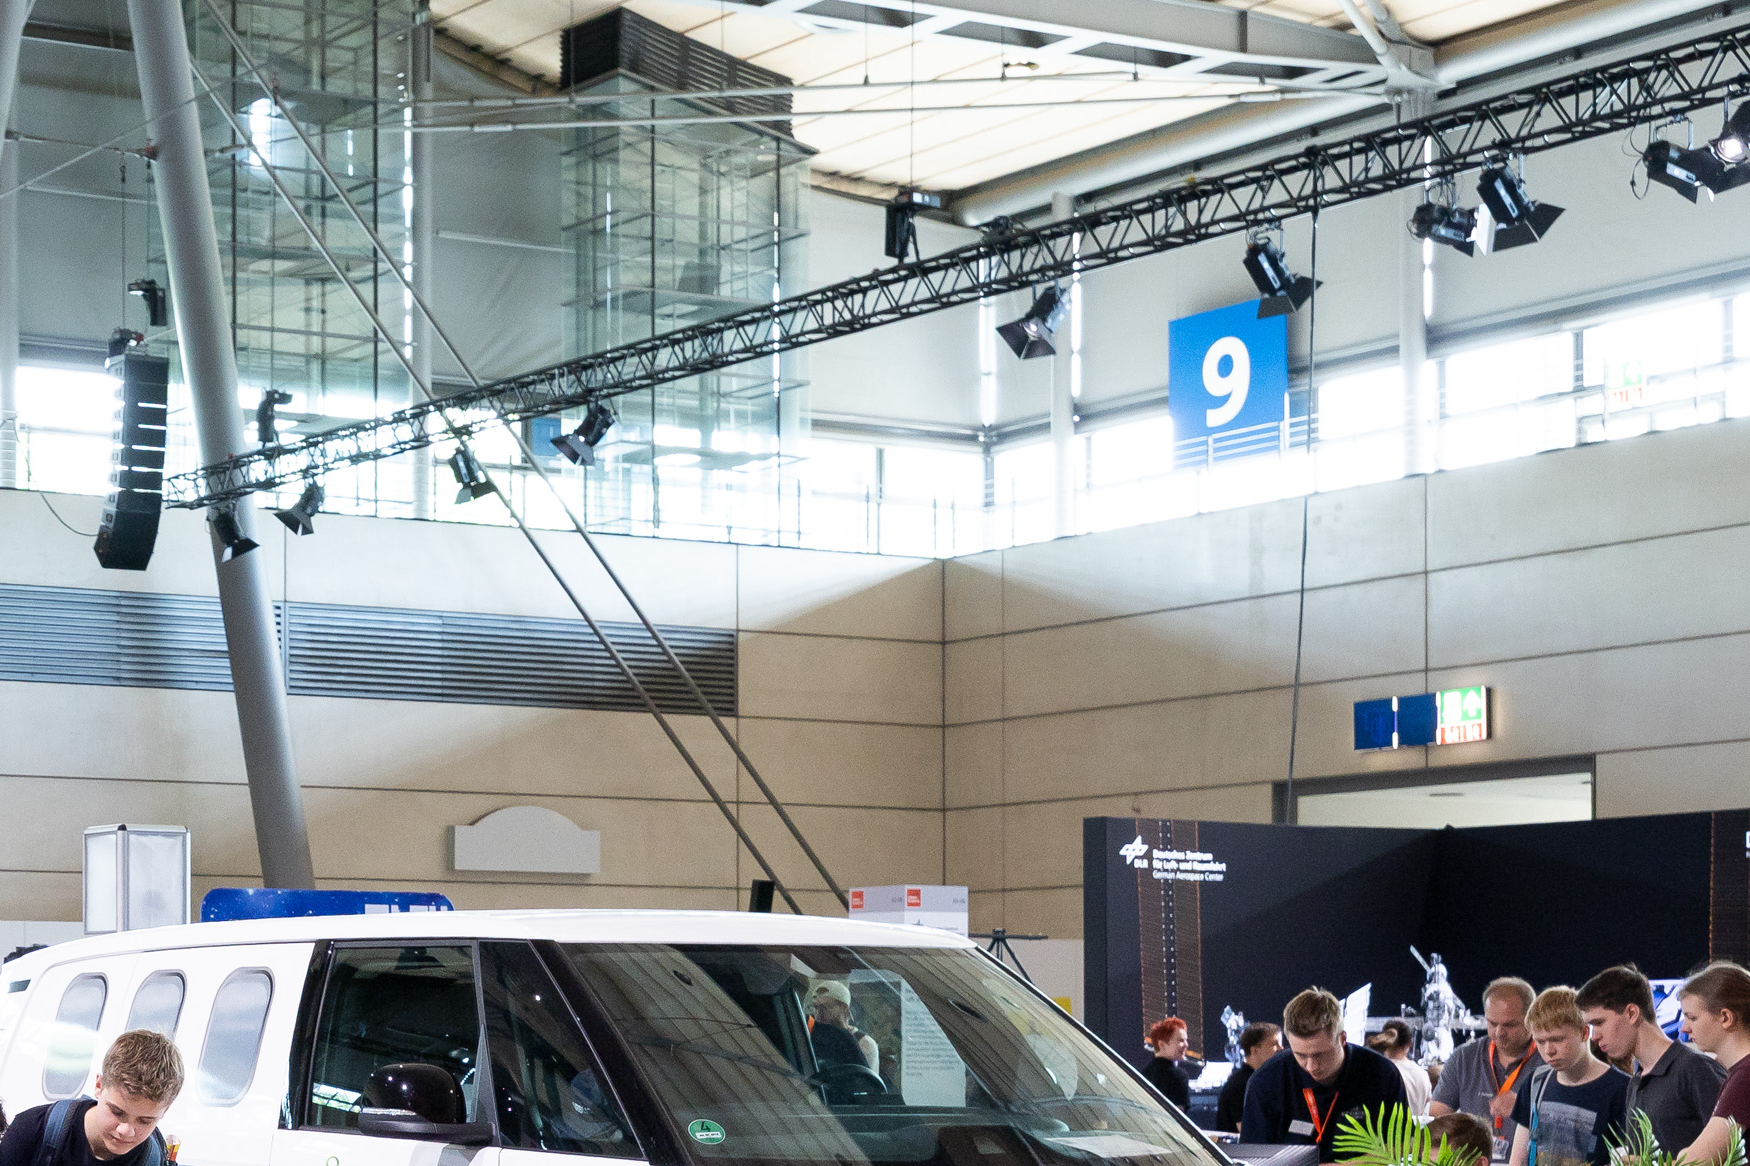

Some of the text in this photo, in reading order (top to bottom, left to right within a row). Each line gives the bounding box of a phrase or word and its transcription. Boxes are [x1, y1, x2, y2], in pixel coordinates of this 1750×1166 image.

[1202, 336, 1251, 428] 9
[1153, 849, 1213, 860] Deutsches Zentrum
[1134, 859, 1148, 868] DLR
[1153, 859, 1226, 871] für Luft- und Raumfahrt
[1153, 871, 1224, 881] German Aerospace Center
[701, 1121, 711, 1132] 4
